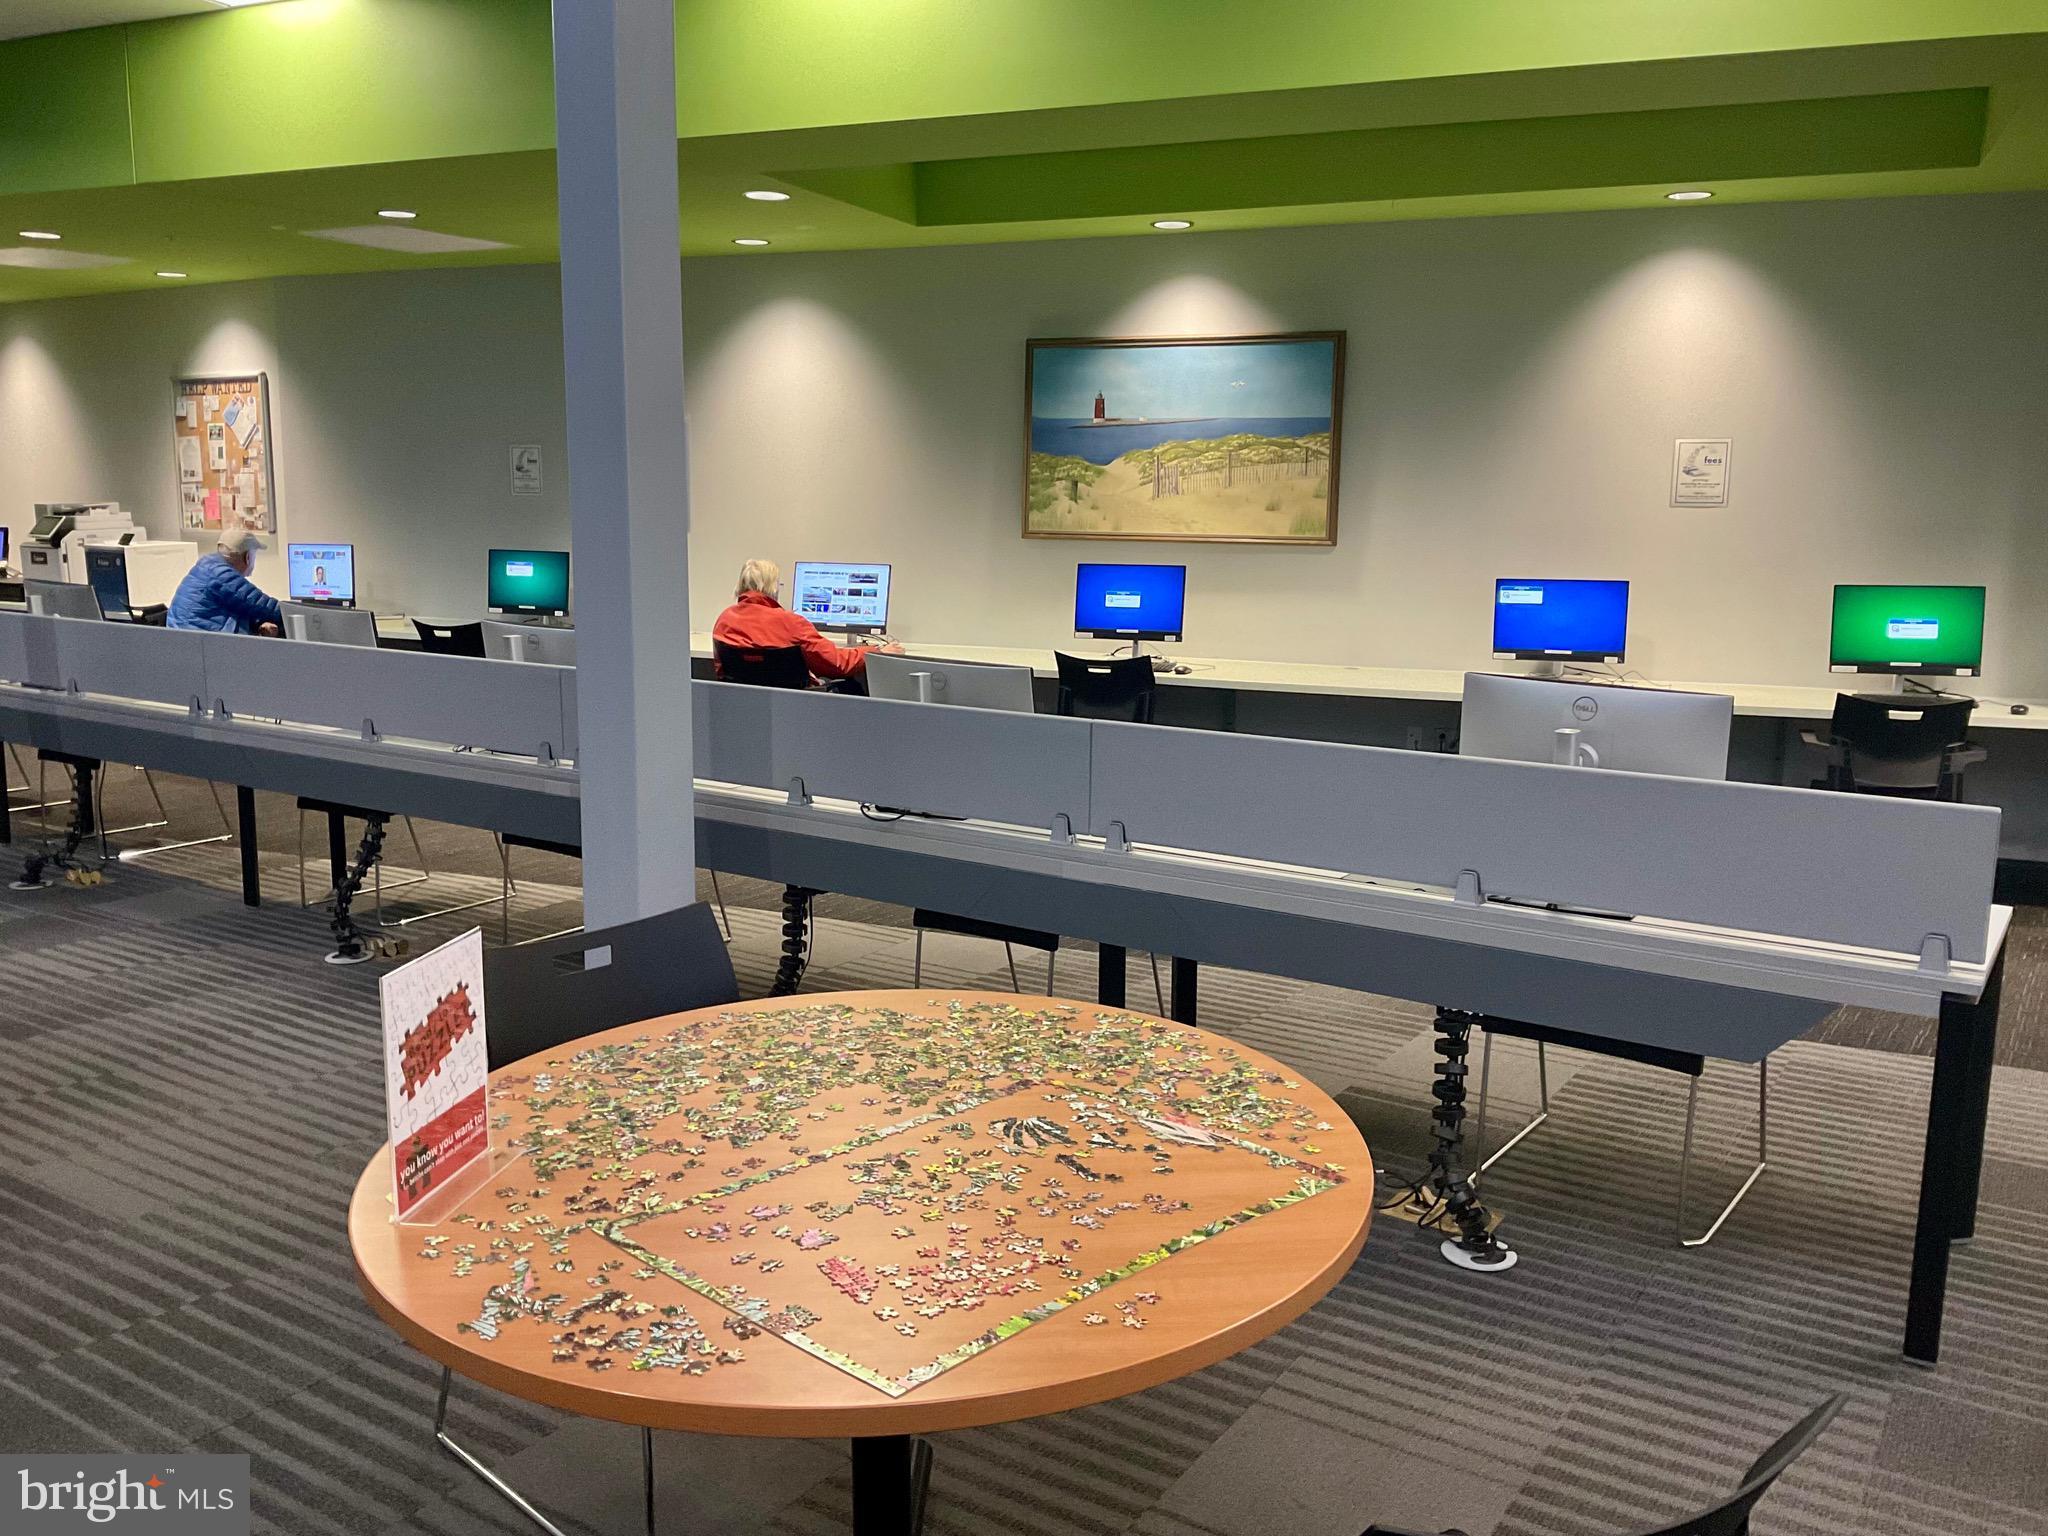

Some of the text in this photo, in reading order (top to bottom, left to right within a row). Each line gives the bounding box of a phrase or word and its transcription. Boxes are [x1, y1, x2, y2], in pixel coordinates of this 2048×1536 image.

[1704, 455, 1722, 464] fees
[1575, 704, 1595, 713] DELL
[400, 1162, 415, 1185] you
[416, 1144, 438, 1169] know
[438, 1133, 454, 1155] you
[454, 1119, 474, 1140] want
